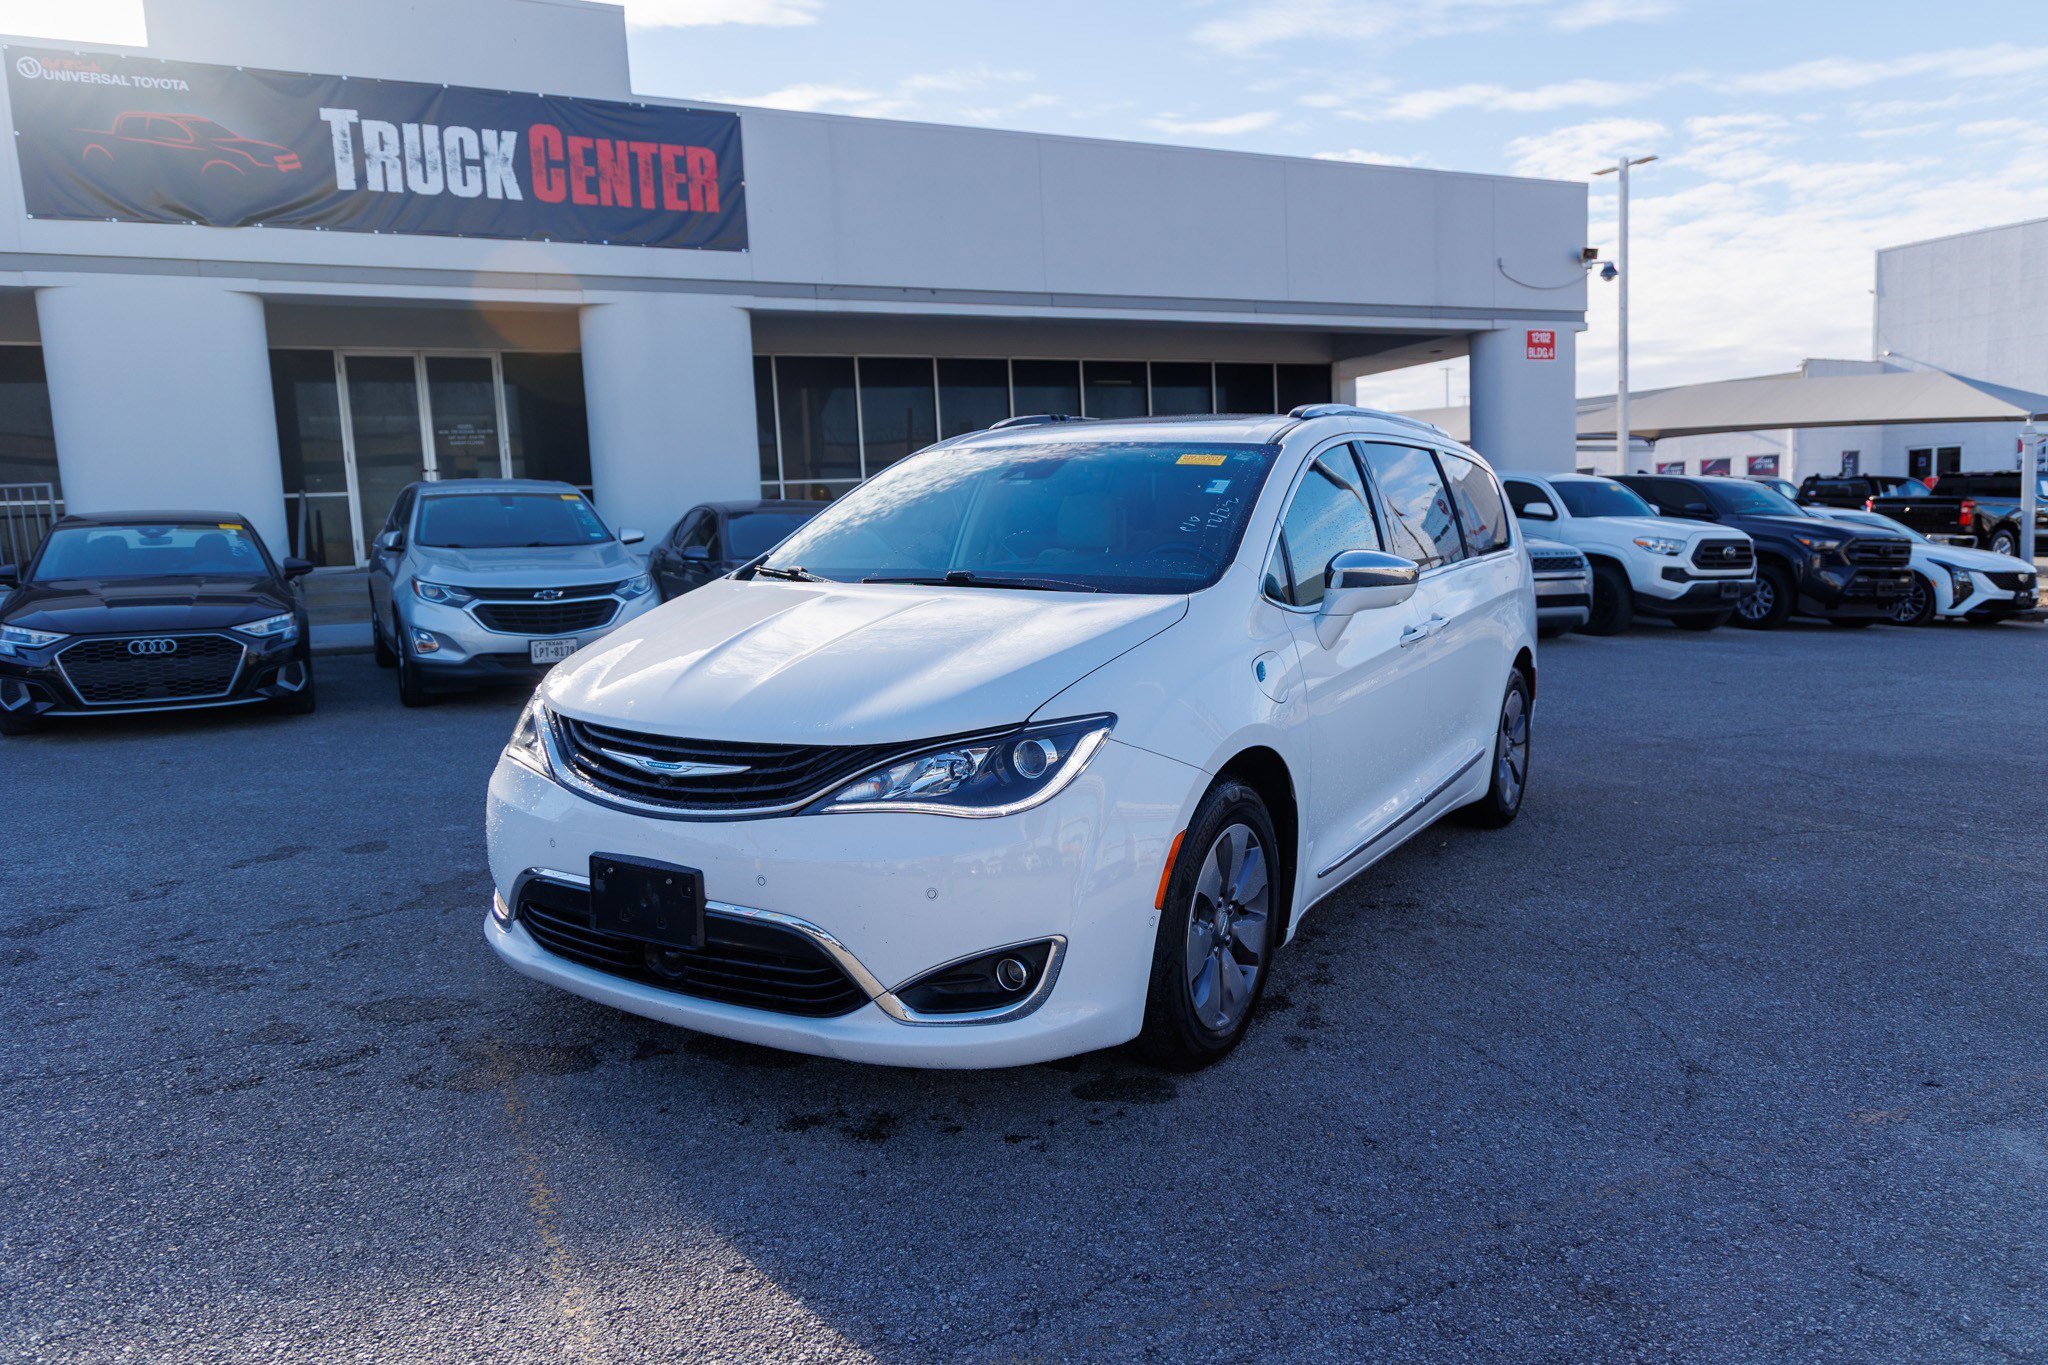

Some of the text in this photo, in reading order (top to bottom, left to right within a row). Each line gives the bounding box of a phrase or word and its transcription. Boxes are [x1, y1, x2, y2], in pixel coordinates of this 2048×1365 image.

[42, 69, 190, 92] UNIVERSAL TOYOTA
[319, 107, 720, 213] TRUCK CENTER
[1531, 332, 1552, 343] 12102
